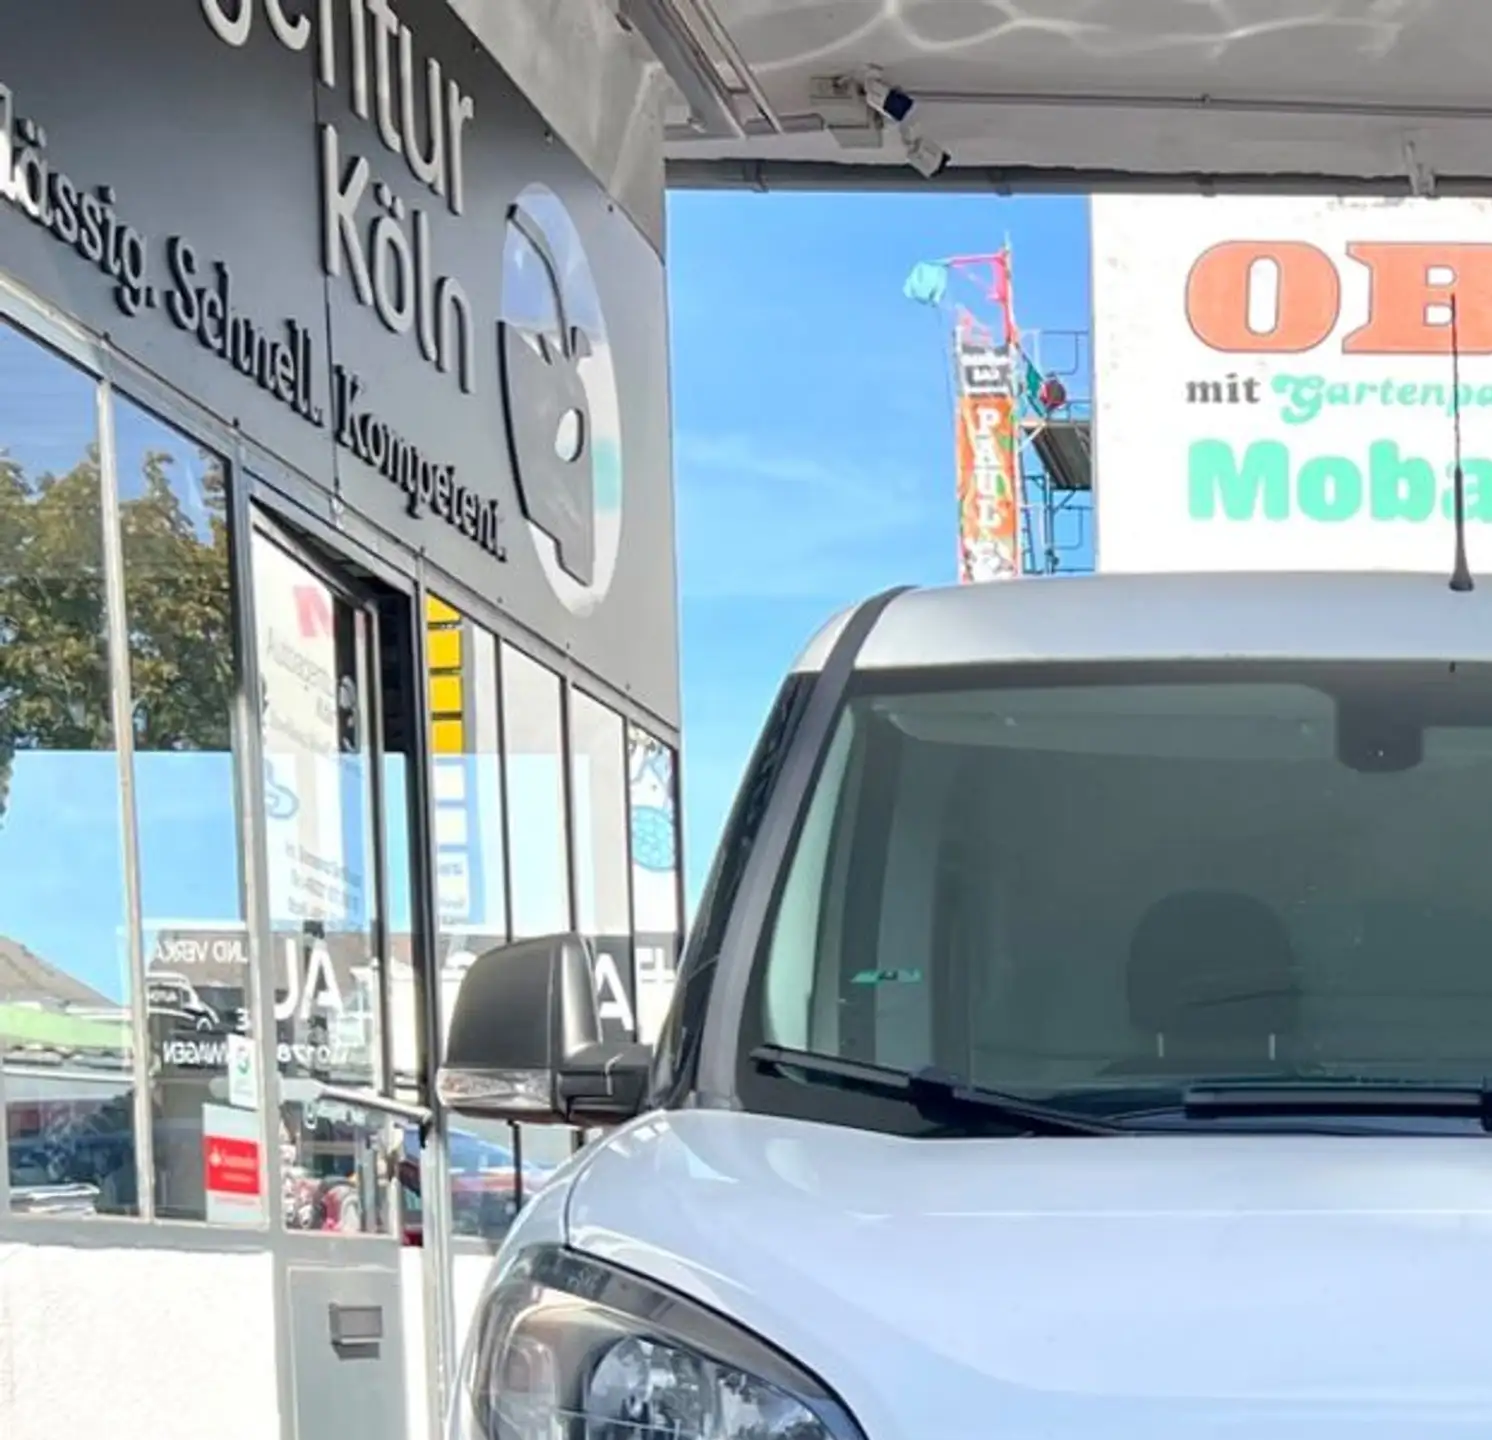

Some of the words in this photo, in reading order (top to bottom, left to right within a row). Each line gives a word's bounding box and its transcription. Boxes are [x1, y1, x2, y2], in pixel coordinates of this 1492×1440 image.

[164, 234, 326, 430] Schnell.
[317, 122, 476, 395] Köln
[1185, 373, 1262, 405] mit
